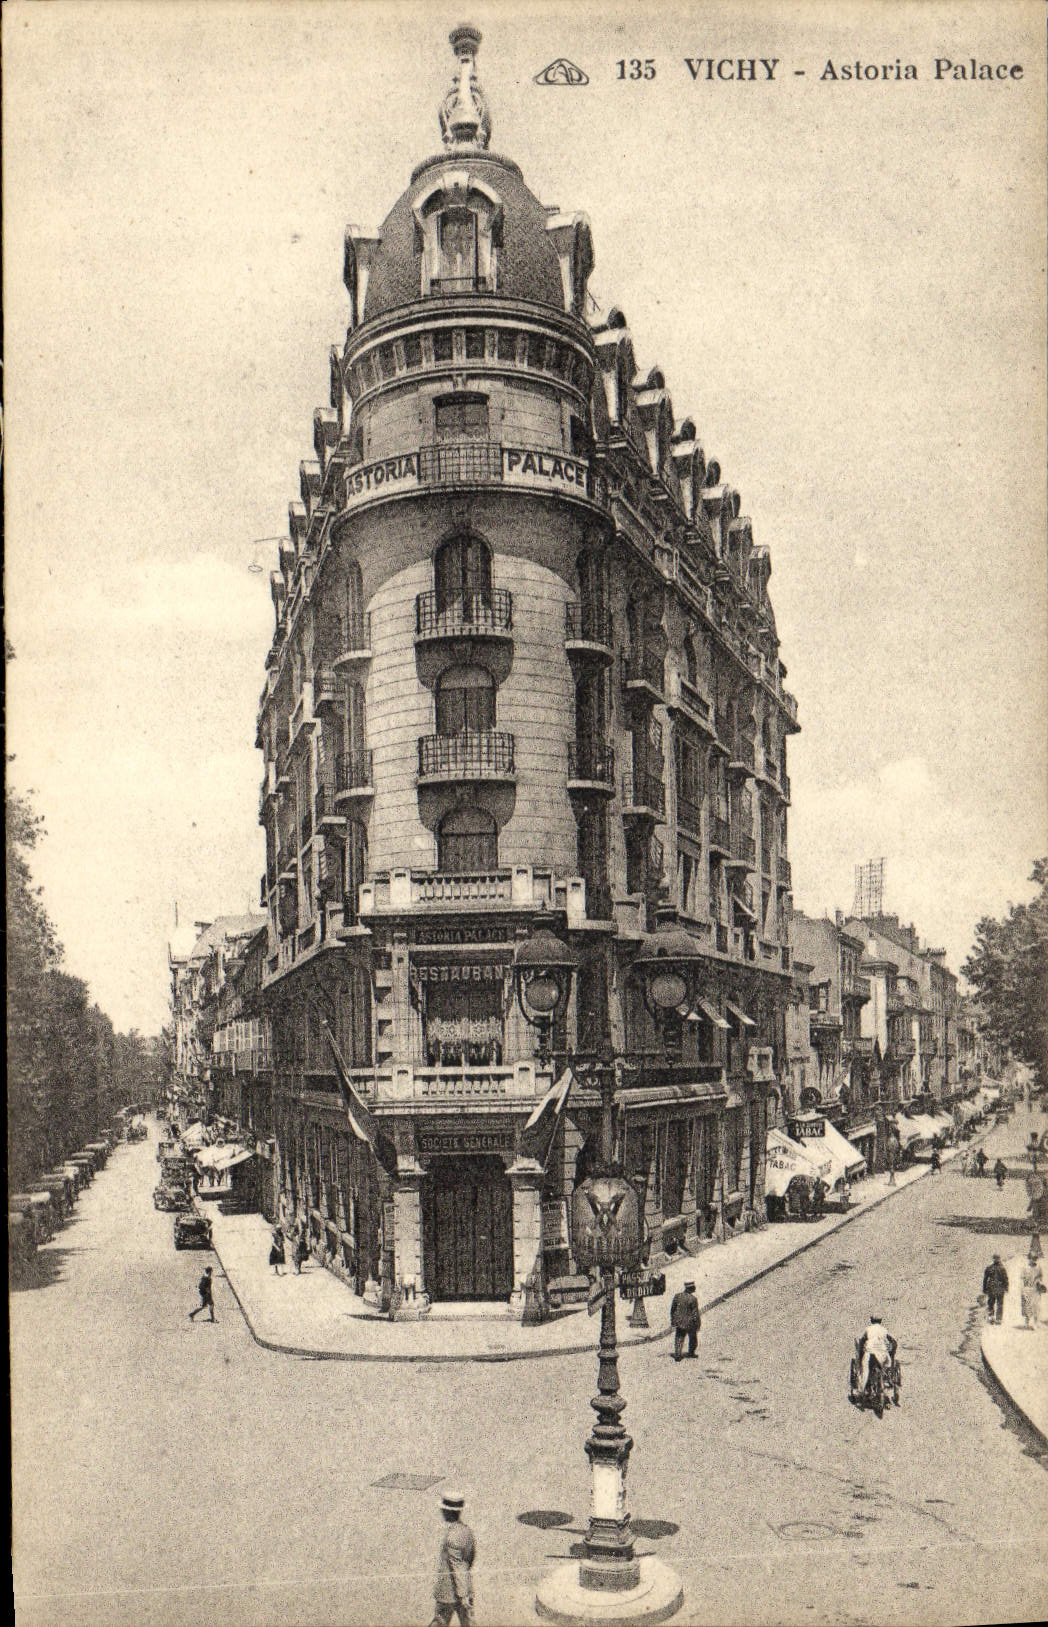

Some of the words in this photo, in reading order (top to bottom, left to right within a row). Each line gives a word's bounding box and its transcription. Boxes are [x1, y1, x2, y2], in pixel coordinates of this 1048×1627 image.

[347, 456, 416, 498] ASTORIA
[507, 450, 585, 488] PALACE
[795, 1127, 823, 1137] TABAC
[769, 1159, 797, 1172] TABAC
